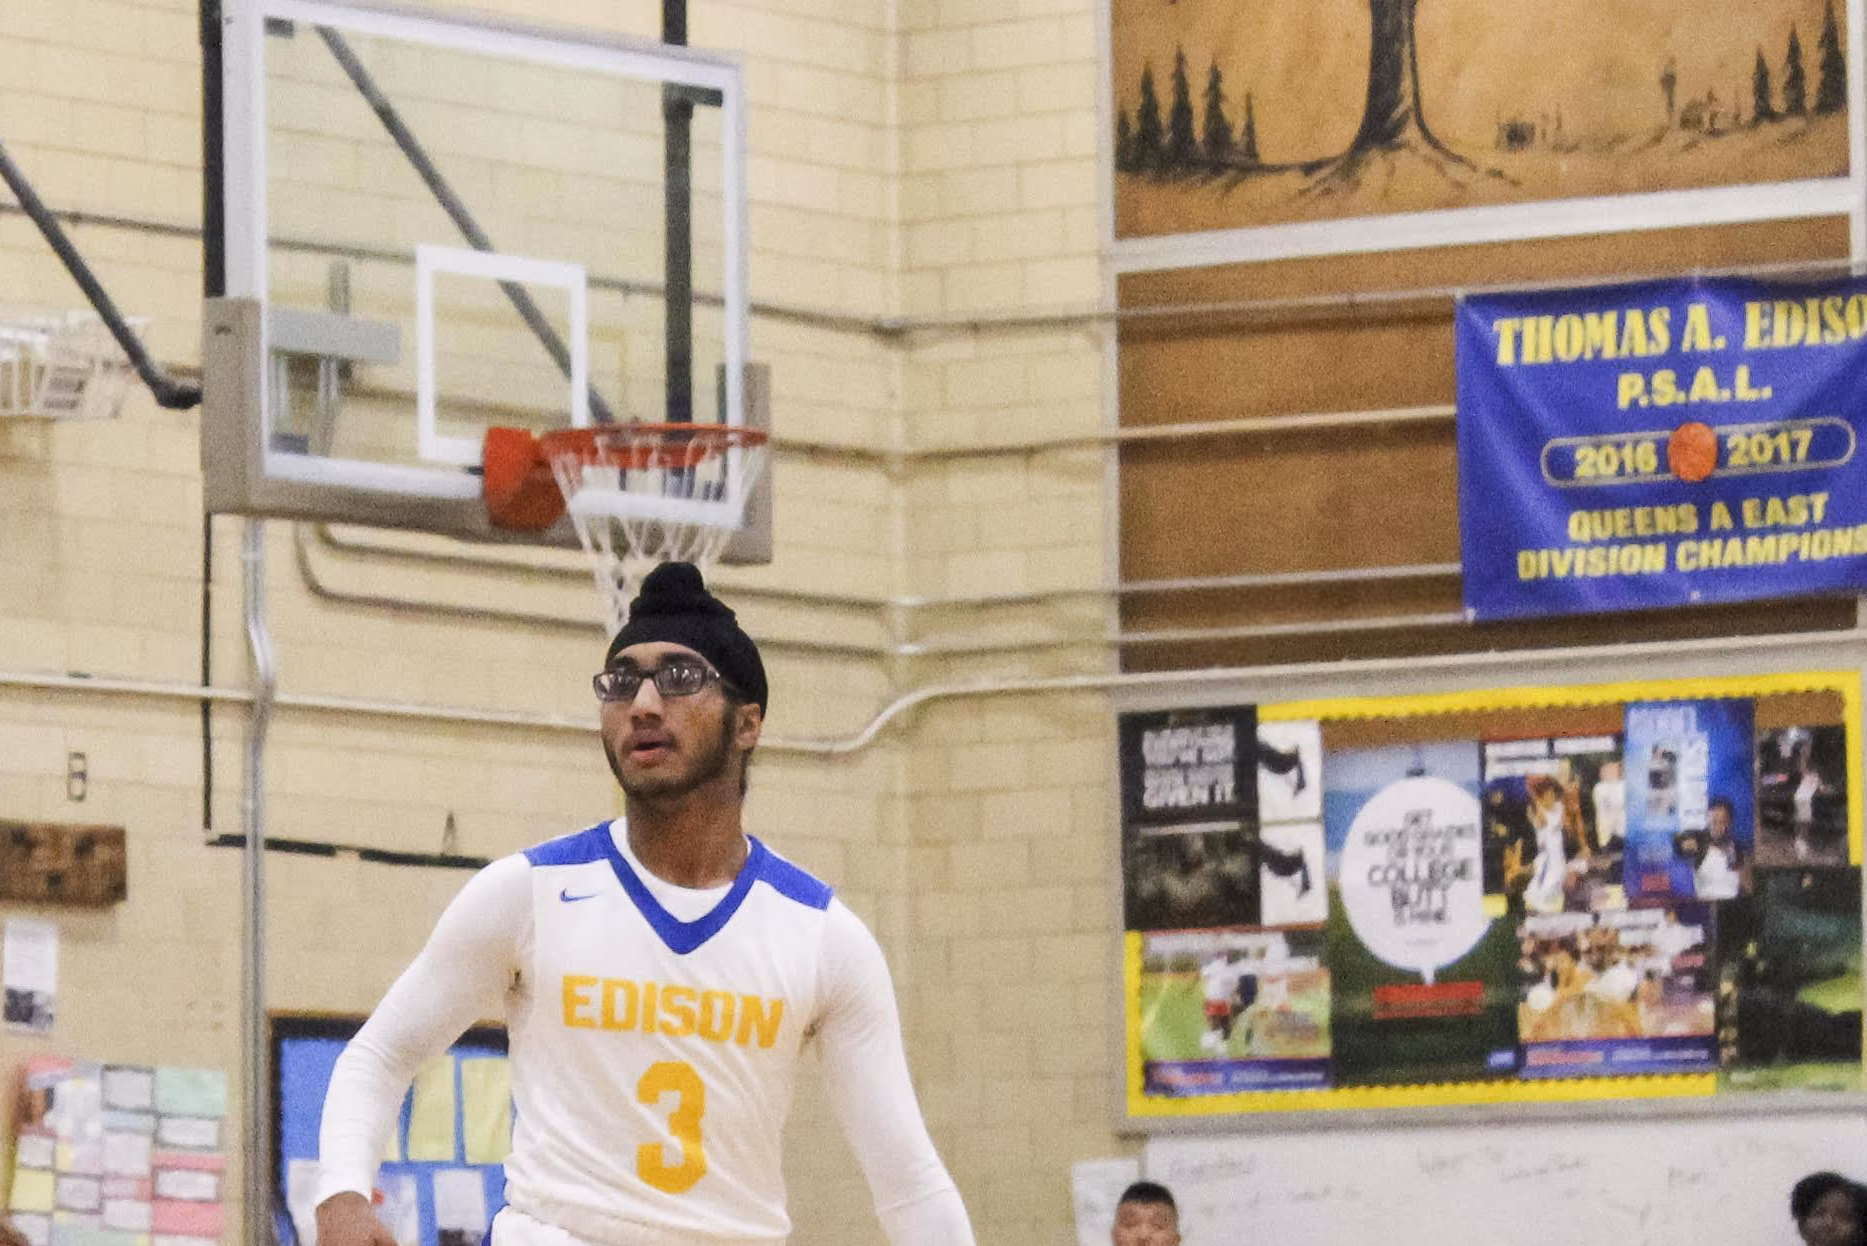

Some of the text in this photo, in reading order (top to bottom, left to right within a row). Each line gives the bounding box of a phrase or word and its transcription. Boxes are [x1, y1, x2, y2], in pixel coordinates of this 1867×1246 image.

[1493, 305, 1671, 367] THOMAS
[1682, 302, 1727, 352] A.
[1617, 364, 1773, 410] P.S.A.L.
[1573, 429, 1814, 478] 2016 2017
[1568, 492, 1829, 542] QUEENS A EAST
[1517, 542, 1667, 582] DIVISION
[562, 976, 785, 1049] EDISON
[636, 1060, 708, 1195] 3
